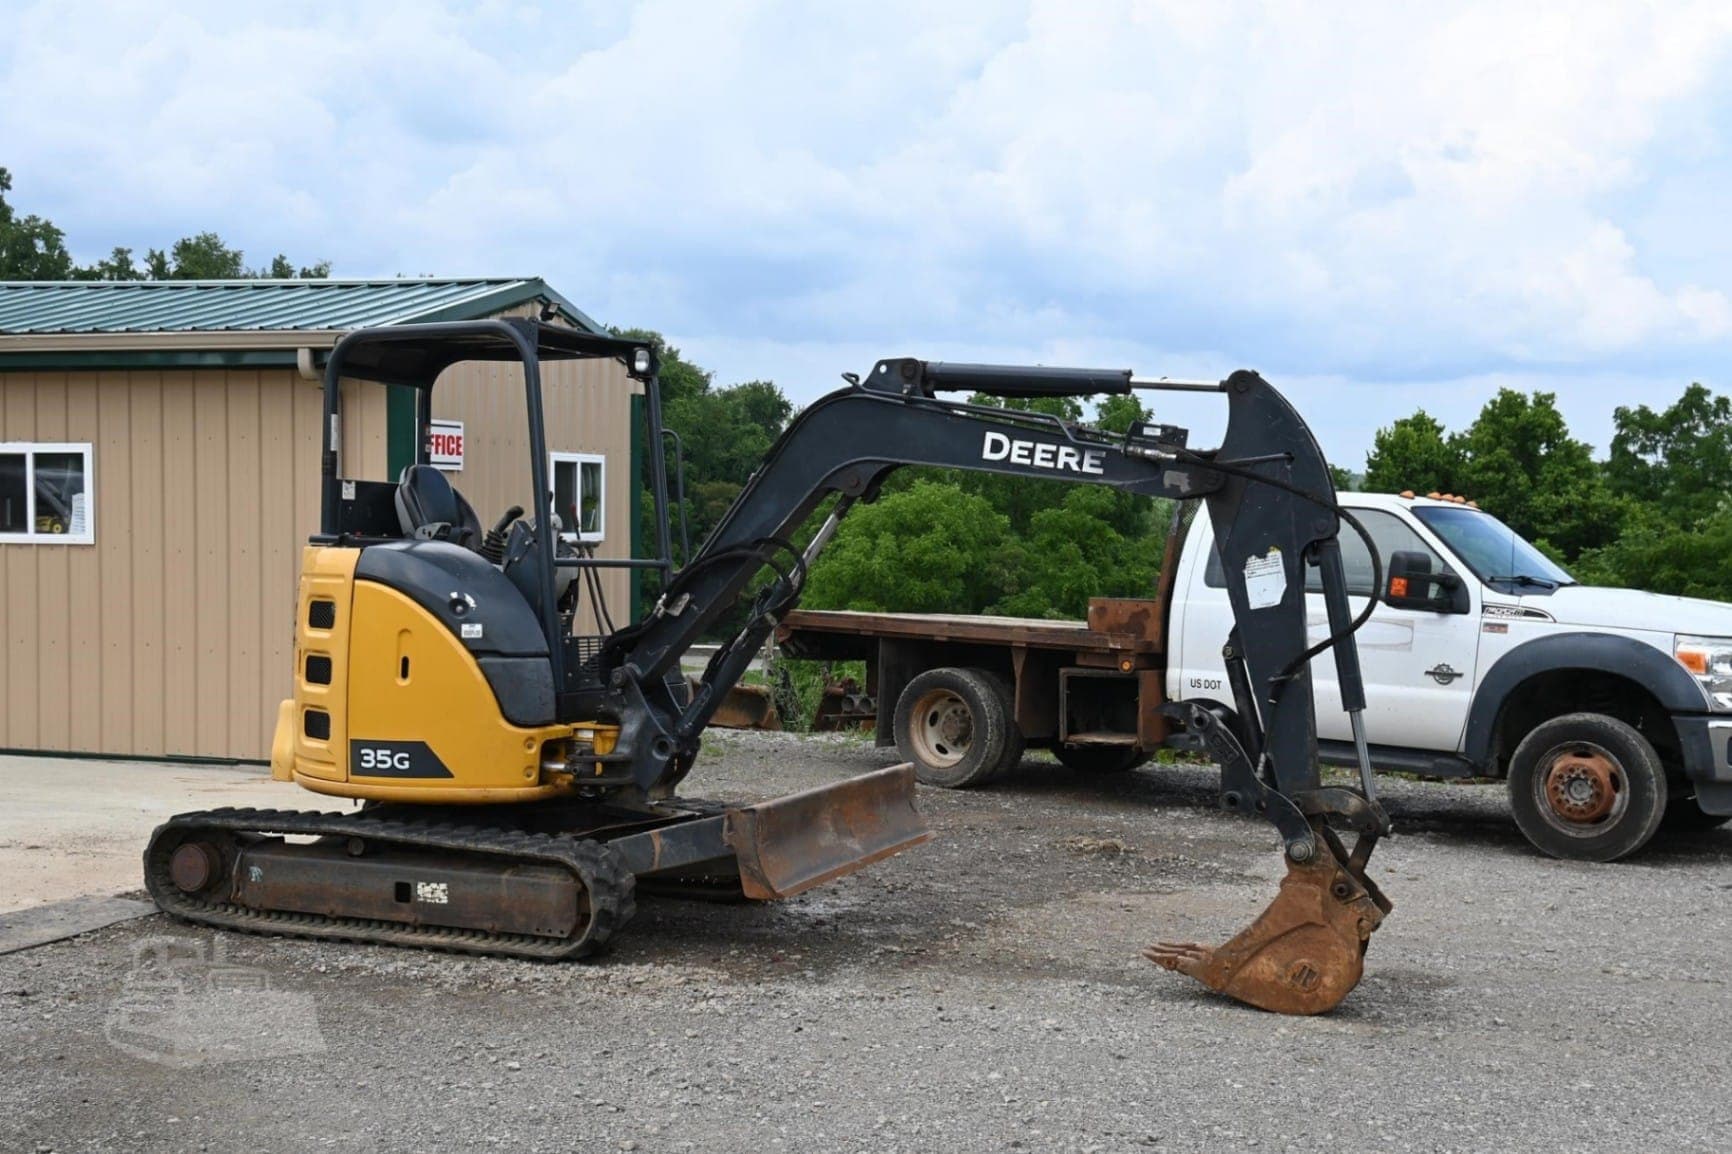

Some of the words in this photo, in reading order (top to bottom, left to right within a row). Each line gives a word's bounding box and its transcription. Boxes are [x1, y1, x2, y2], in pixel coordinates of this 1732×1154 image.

[430, 434, 462, 456] FICE
[982, 431, 1106, 475] DEERE
[1190, 678, 1202, 689] US
[1204, 679, 1222, 690] DOT
[360, 748, 410, 770] 35G
